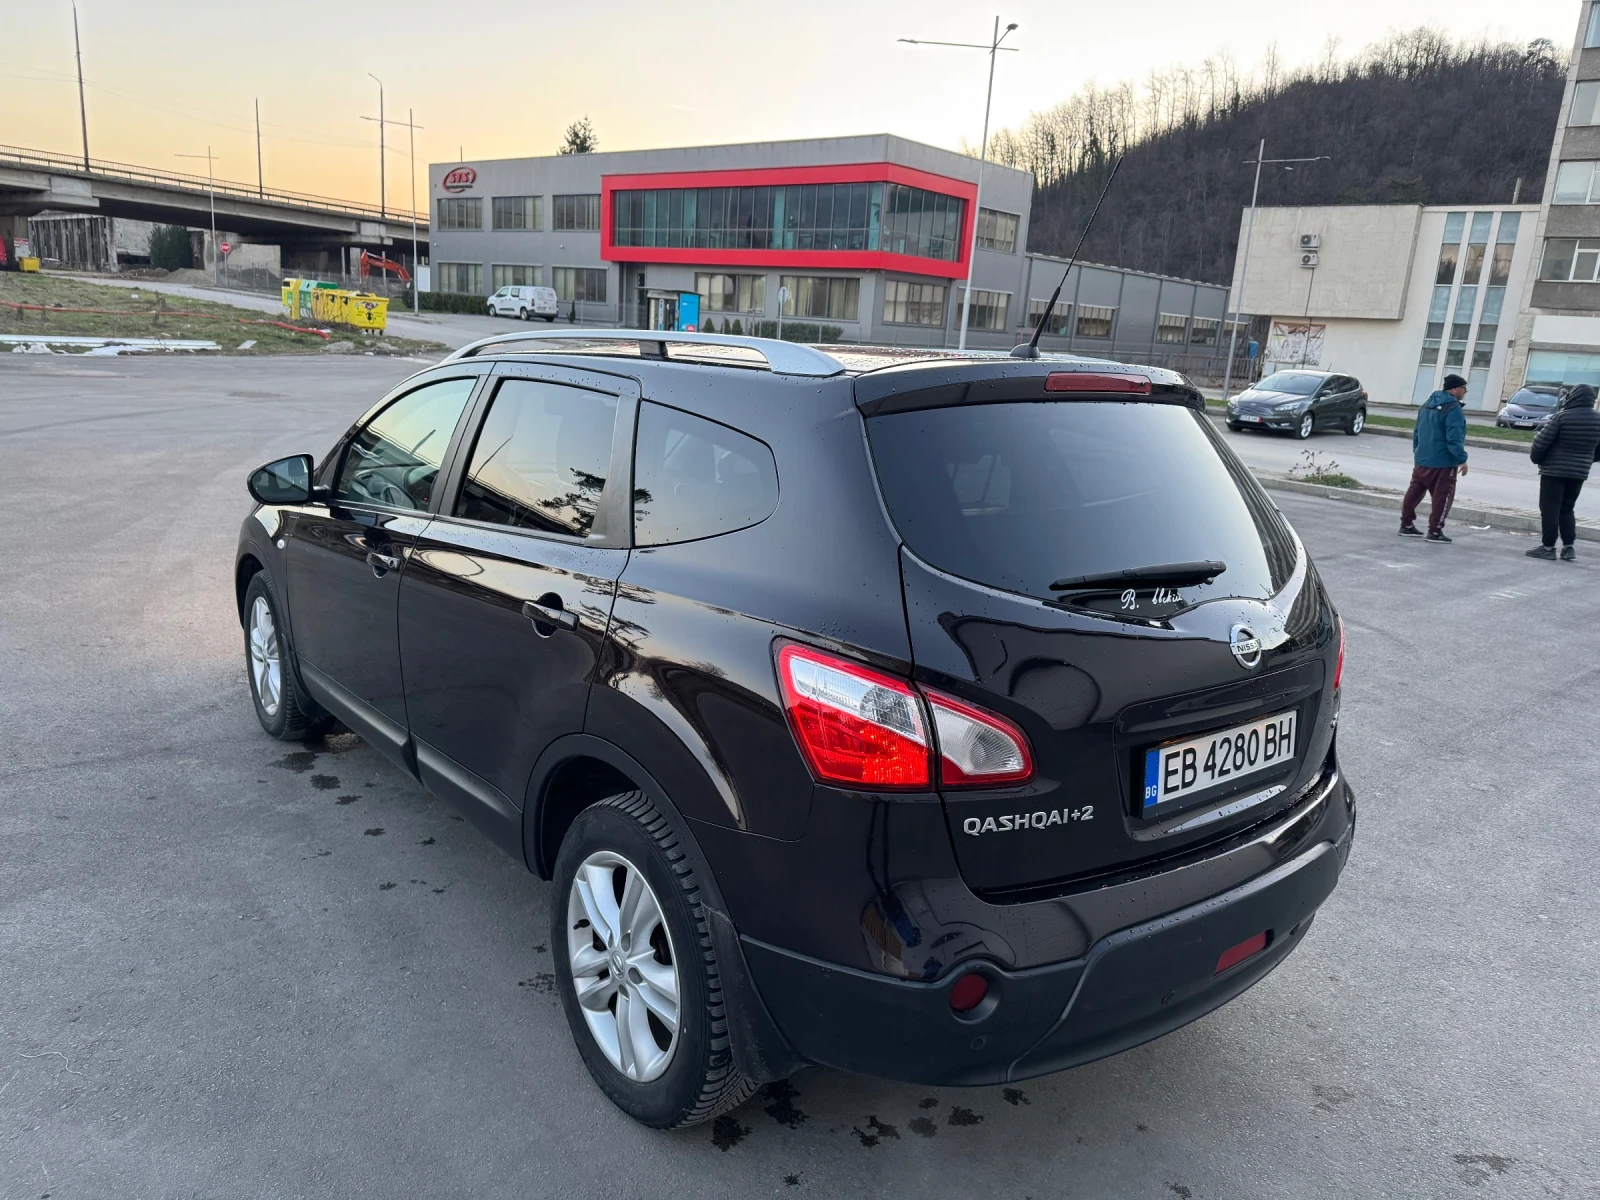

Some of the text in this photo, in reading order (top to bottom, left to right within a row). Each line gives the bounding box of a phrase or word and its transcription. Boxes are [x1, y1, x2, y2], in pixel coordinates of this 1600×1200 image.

[1163, 717, 1293, 795] EB 4280 BH
[1145, 785, 1158, 799] BG
